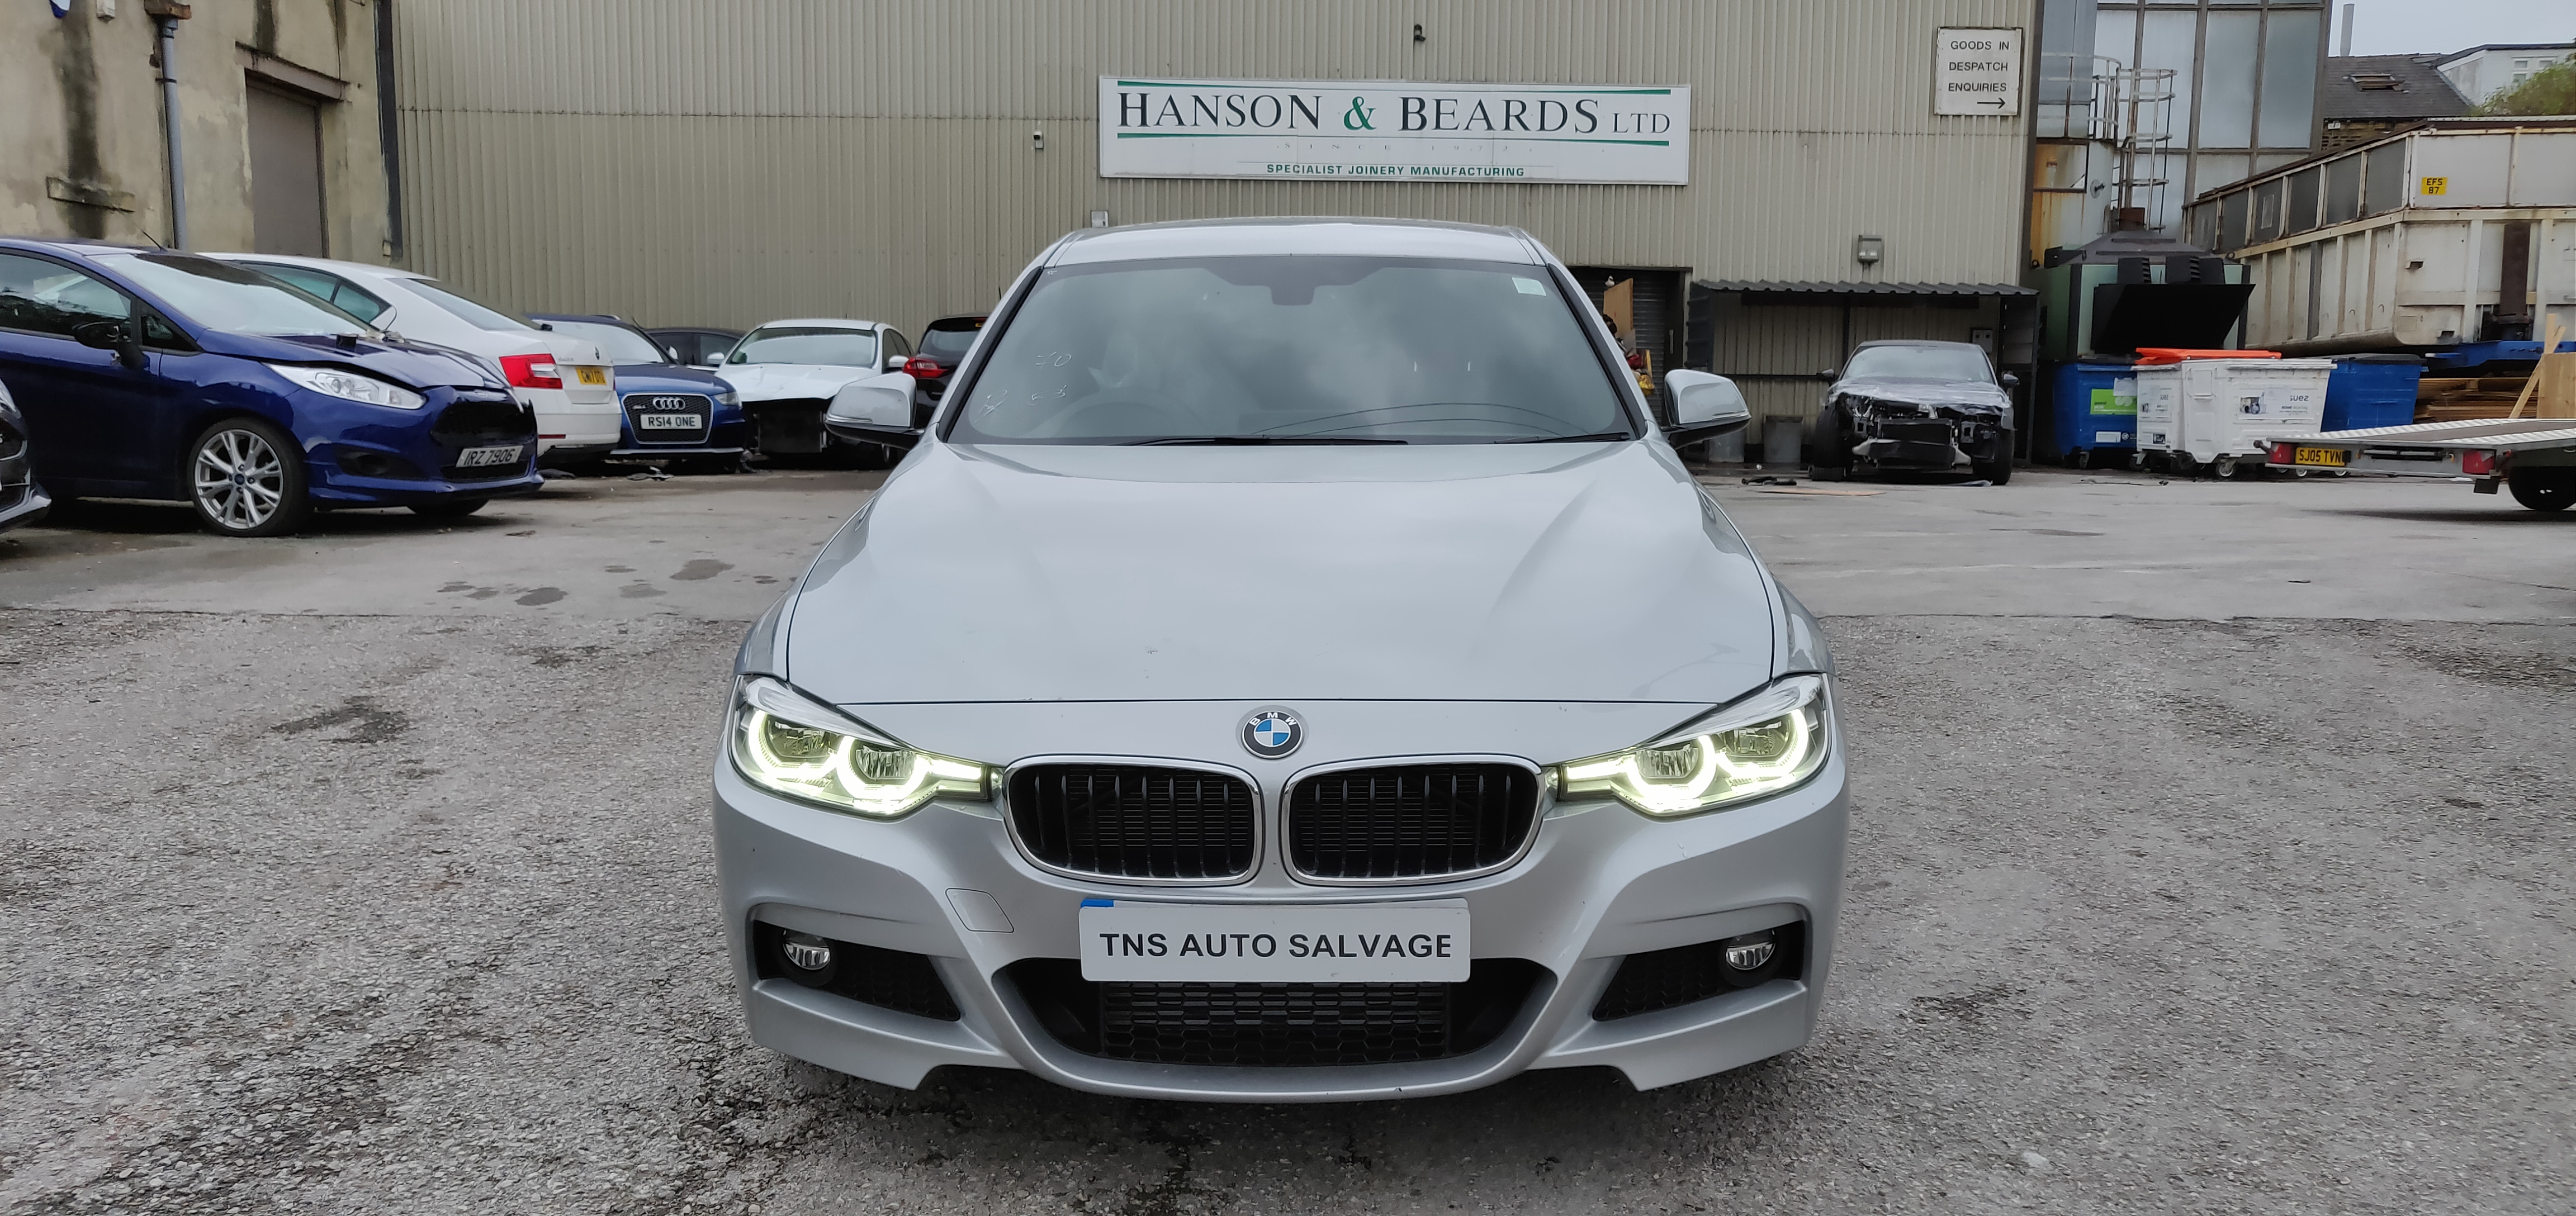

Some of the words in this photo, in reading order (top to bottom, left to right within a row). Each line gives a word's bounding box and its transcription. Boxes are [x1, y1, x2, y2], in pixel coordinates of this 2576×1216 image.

[1950, 41, 1992, 50] GOODS
[1999, 41, 2010, 50] IN
[1949, 61, 2008, 71] DESPATCH
[1948, 83, 2007, 92] ENQUIRIES
[1117, 93, 1323, 130] HANSON
[1343, 96, 1377, 131] &
[1398, 97, 1598, 134] BEARDS
[1612, 112, 1670, 134] LTD
[1266, 164, 1342, 174] SPECIALIST
[1348, 165, 1404, 175] JOINERY
[1410, 166, 1525, 177] MANUFACTURING
[648, 416, 672, 426] RS14
[675, 416, 695, 426] ONE
[463, 450, 486, 466] IRZ
[485, 448, 515, 464] 7906
[2299, 449, 2321, 462] SJ05
[2324, 450, 2341, 463] TVN
[1249, 712, 1297, 726] BMW
[1099, 933, 1167, 956] TNS
[1179, 933, 1277, 957] AUTO
[1289, 934, 1451, 958] SALVAGE
